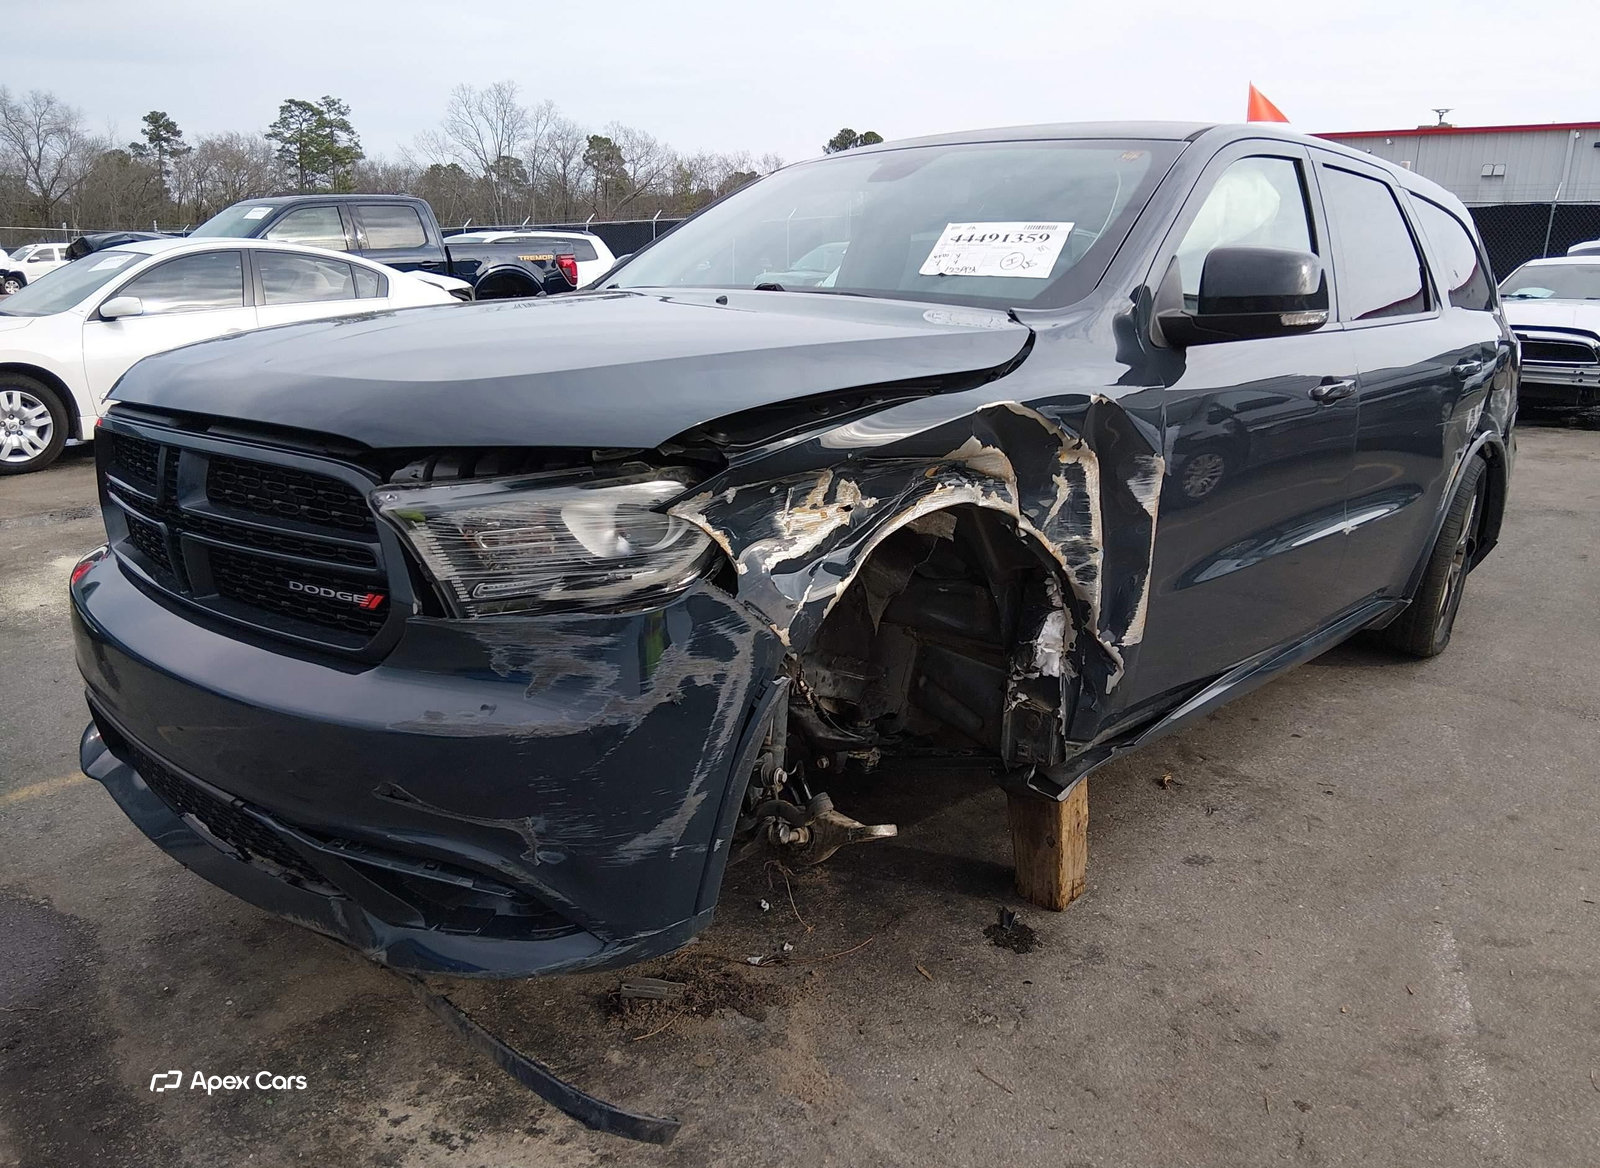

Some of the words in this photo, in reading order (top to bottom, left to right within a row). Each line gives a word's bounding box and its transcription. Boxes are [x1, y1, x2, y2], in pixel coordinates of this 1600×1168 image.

[950, 233, 1051, 244] 44491359
[518, 254, 554, 262] TREMOR
[289, 580, 370, 605] DODGE
